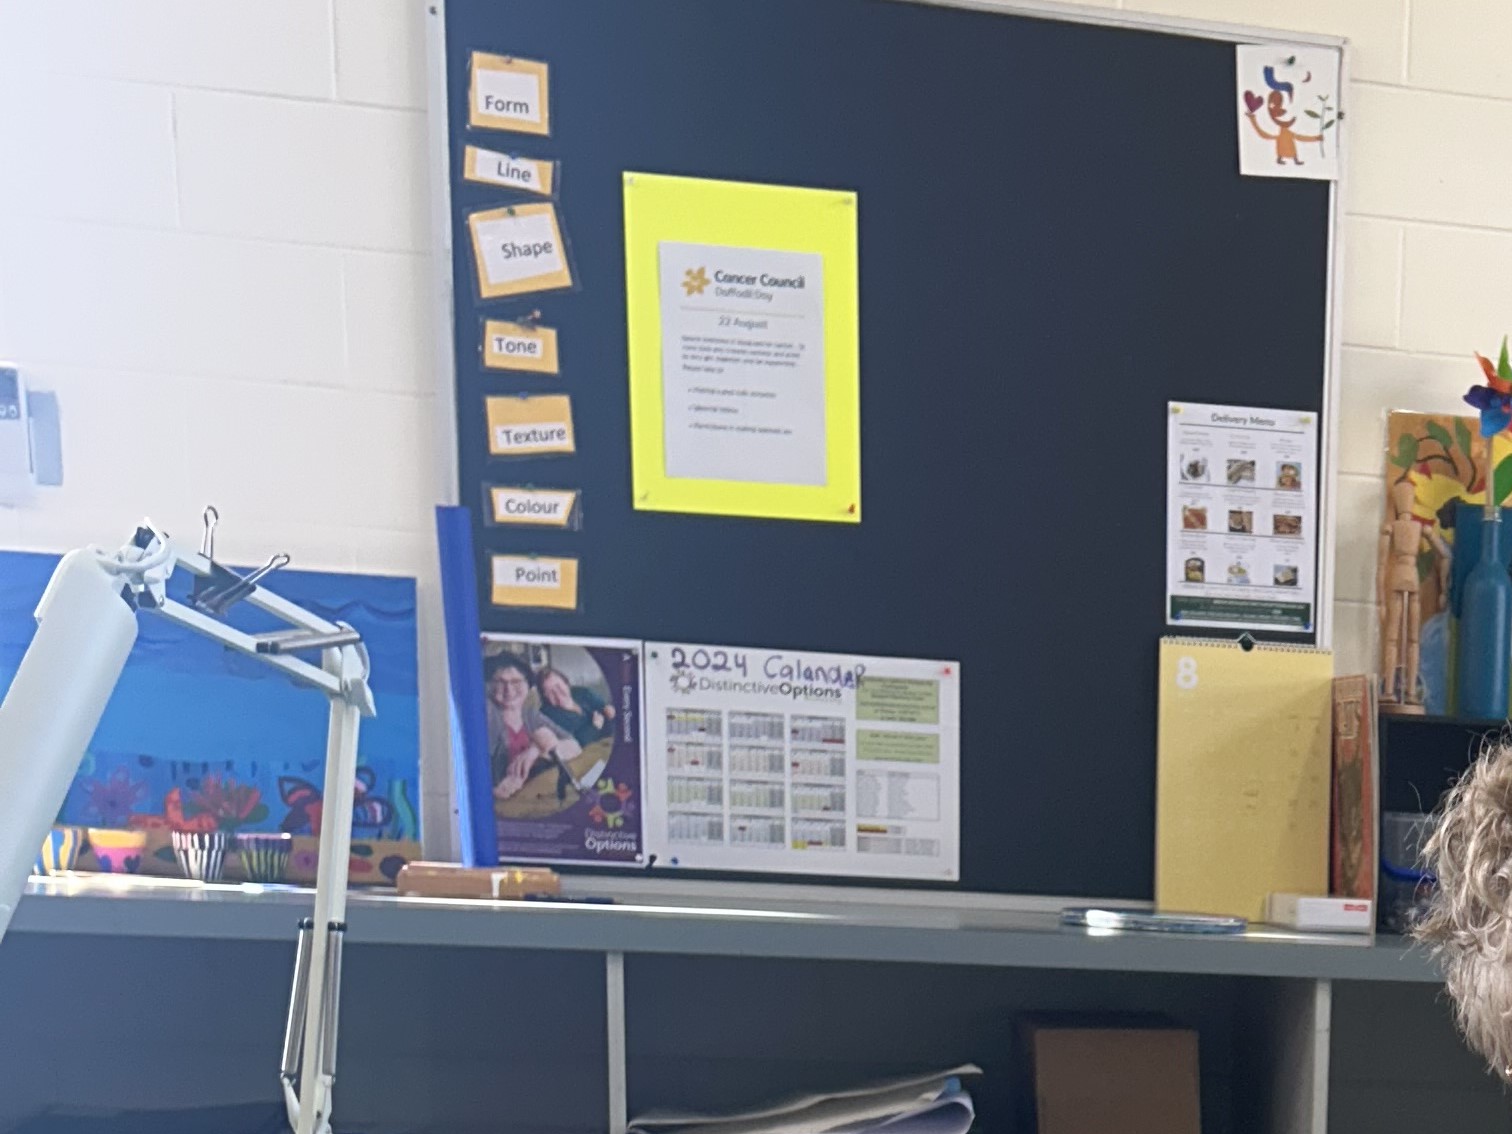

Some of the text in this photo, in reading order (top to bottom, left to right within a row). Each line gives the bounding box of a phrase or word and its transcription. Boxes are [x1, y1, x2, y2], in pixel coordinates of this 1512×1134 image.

[485, 95, 529, 114] Form
[497, 161, 532, 183] Line
[501, 240, 553, 260] Shape
[714, 270, 806, 289] Cancer Council
[495, 337, 537, 354] Tone
[1211, 412, 1276, 427] Delivery Menu
[503, 427, 567, 445] Texture
[505, 498, 560, 515] Colour
[515, 567, 557, 583] Point
[671, 647, 748, 678] 2024
[585, 837, 637, 854] Options
